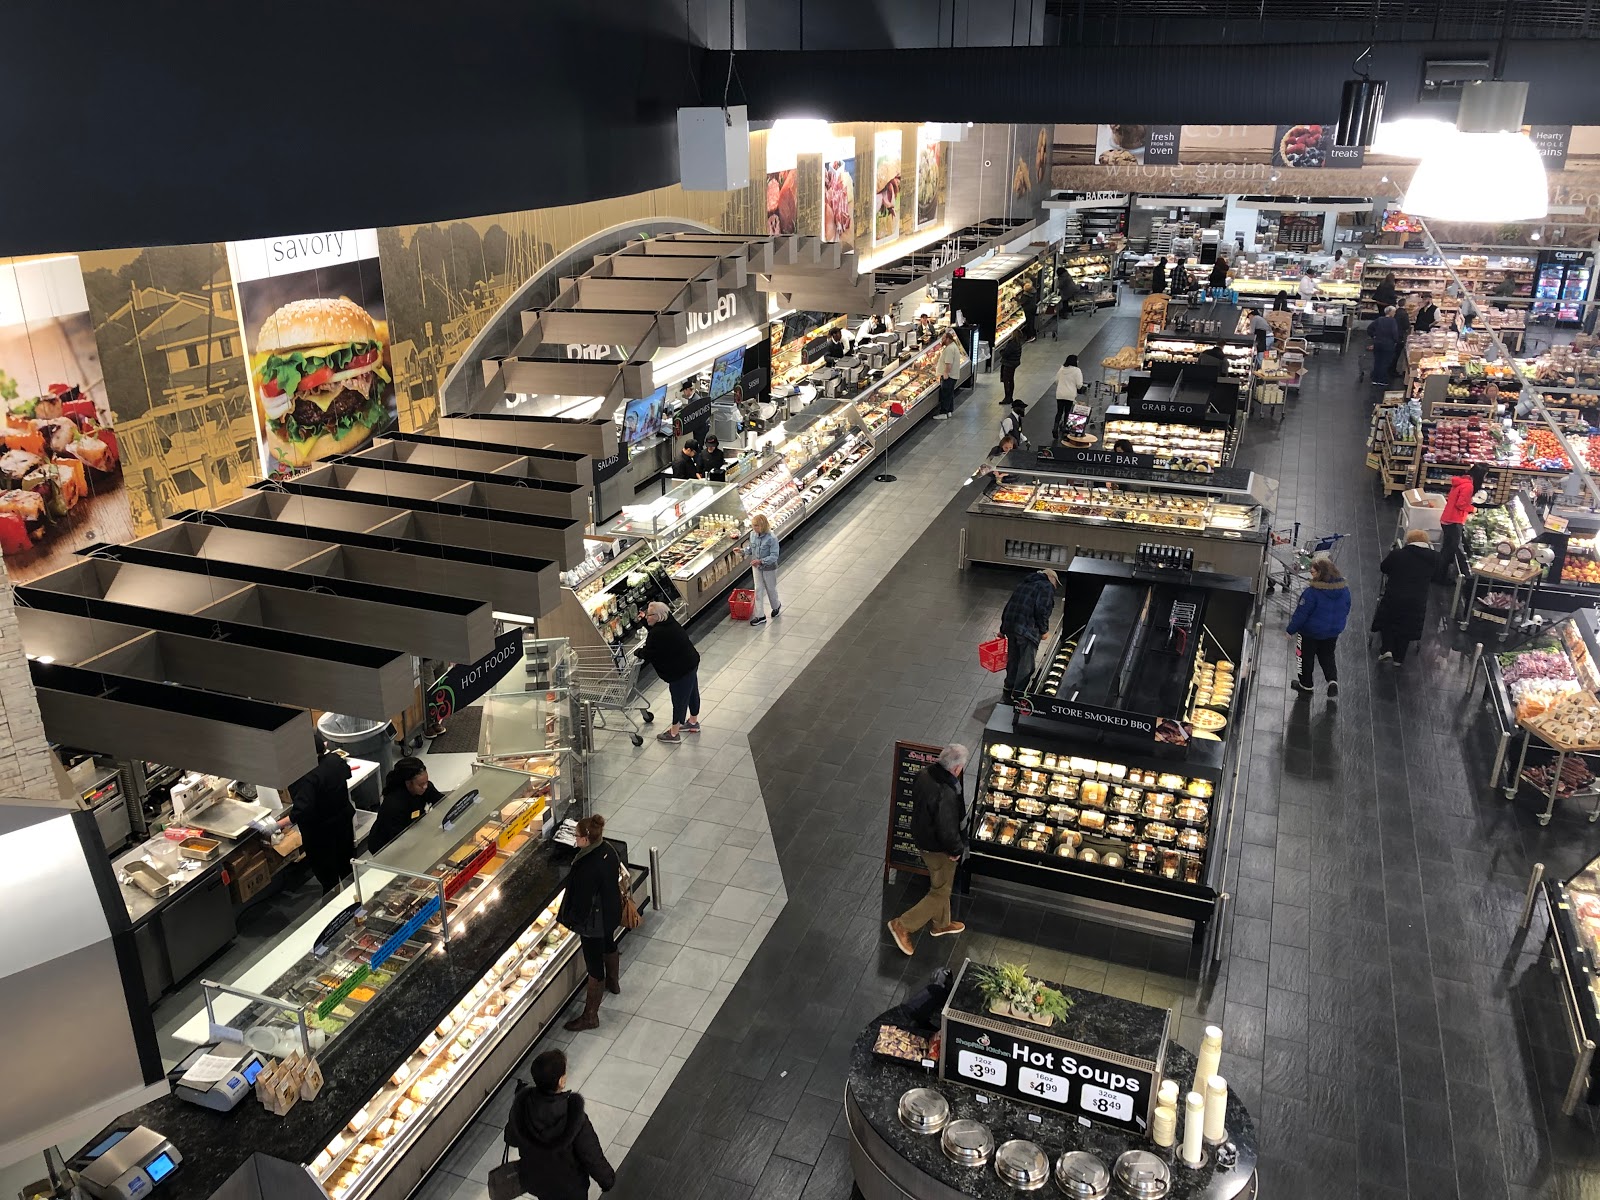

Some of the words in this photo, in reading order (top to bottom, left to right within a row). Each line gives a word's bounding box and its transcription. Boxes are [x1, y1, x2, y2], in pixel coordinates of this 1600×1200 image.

[1151, 132, 1175, 141] fresh
[1536, 132, 1564, 141] Hearty
[1331, 150, 1359, 158] treats
[1539, 148, 1563, 157] ains
[1086, 190, 1119, 201] BAKERY
[273, 232, 344, 262] savory
[940, 236, 961, 268] DELI
[683, 403, 711, 425] SANDWICHES
[1141, 403, 1167, 411] GRAB
[1179, 406, 1193, 414] GO
[597, 454, 619, 472] SALADS
[1077, 452, 1112, 463] OLIVE
[1116, 455, 1139, 466] BAR
[461, 665, 482, 690] HOT
[484, 642, 516, 673] FOODS
[1051, 705, 1083, 718] STORE
[1084, 711, 1129, 727] SMOKED
[1130, 720, 1151, 733] BBQ
[975, 1056, 992, 1066] 12oz
[1012, 1042, 1055, 1070] Hot
[1061, 1056, 1140, 1093] Soups
[1035, 1072, 1054, 1083] 16oz
[1098, 1089, 1117, 1100] 32oz
